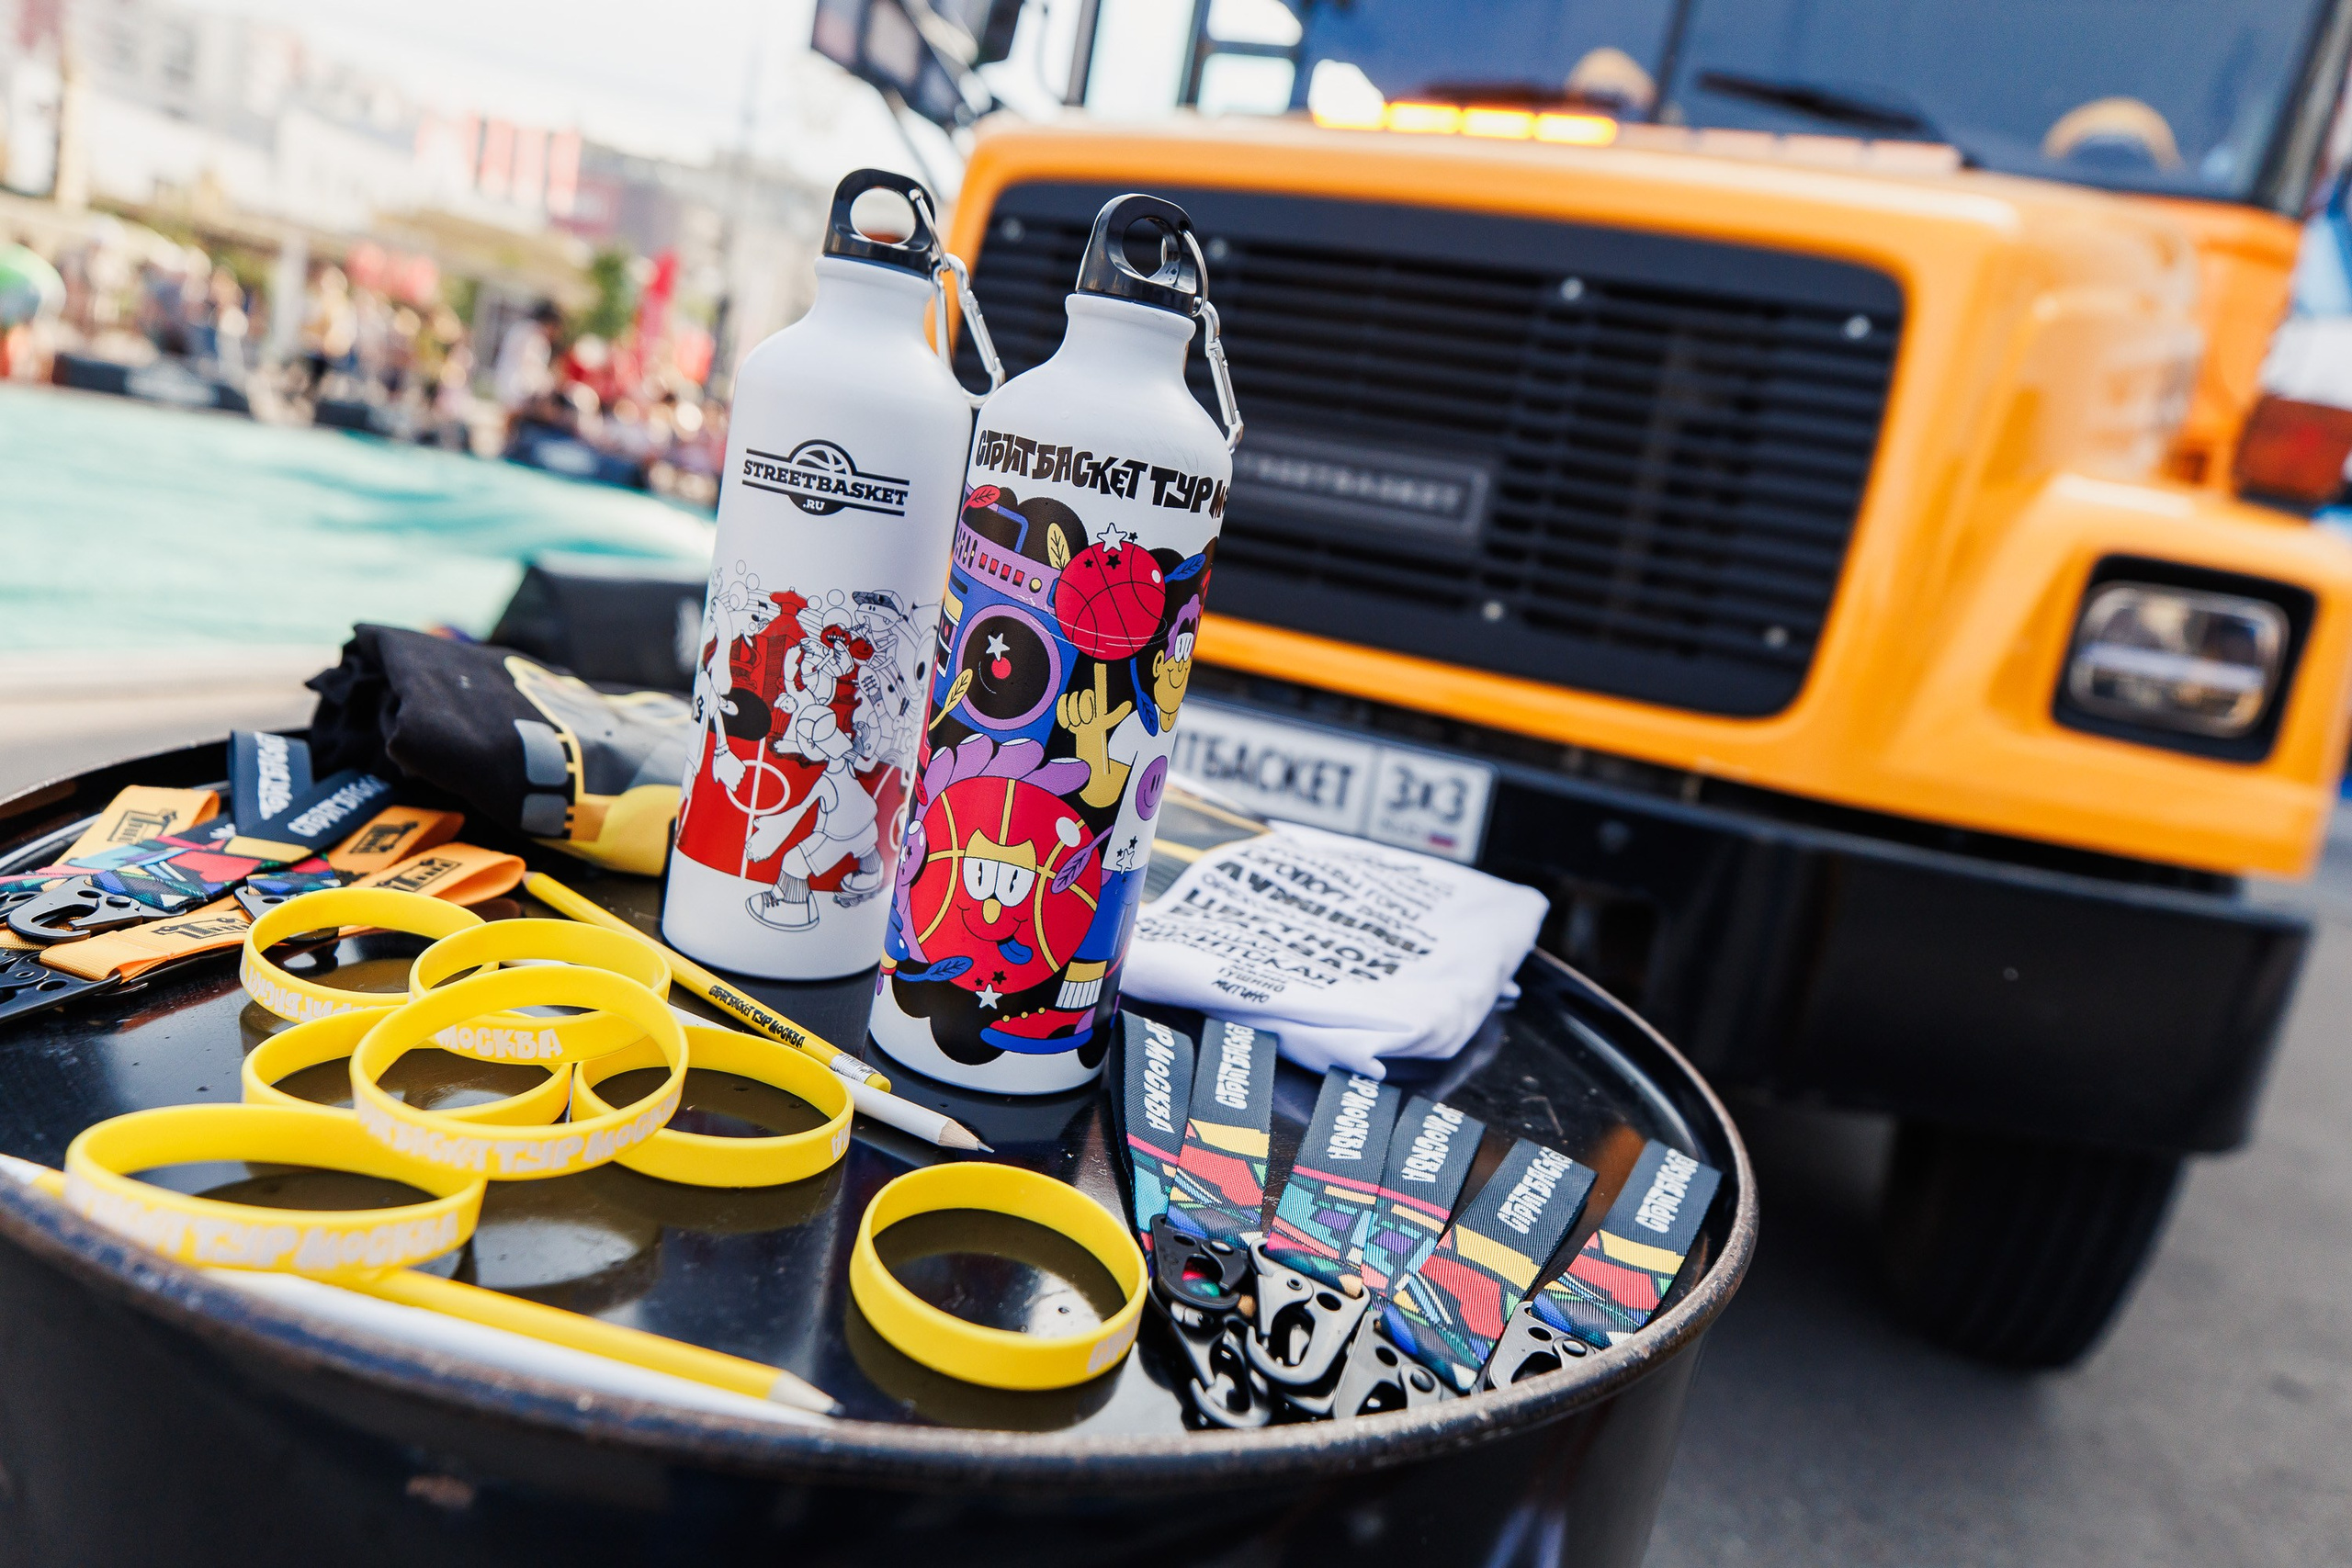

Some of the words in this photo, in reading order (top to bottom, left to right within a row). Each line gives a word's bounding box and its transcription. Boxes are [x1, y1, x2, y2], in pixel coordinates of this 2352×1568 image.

[743, 459, 908, 505] STREETBASKET
[976, 430, 1148, 500] СТРИТБАСКЕТ
[1150, 466, 1214, 513] ТУР
[435, 1024, 563, 1059] МОСКВА
[752, 1010, 773, 1027] ТУР
[768, 1020, 806, 1049] МОСКВА
[1143, 1037, 1175, 1134] МОСКВА
[494, 1134, 585, 1173] ТУР
[1327, 1091, 1376, 1160] МОСКВА
[1401, 1114, 1459, 1183] МОСКВА
[192, 1215, 300, 1269] ТУР
[292, 1210, 459, 1271] МОСКВА
